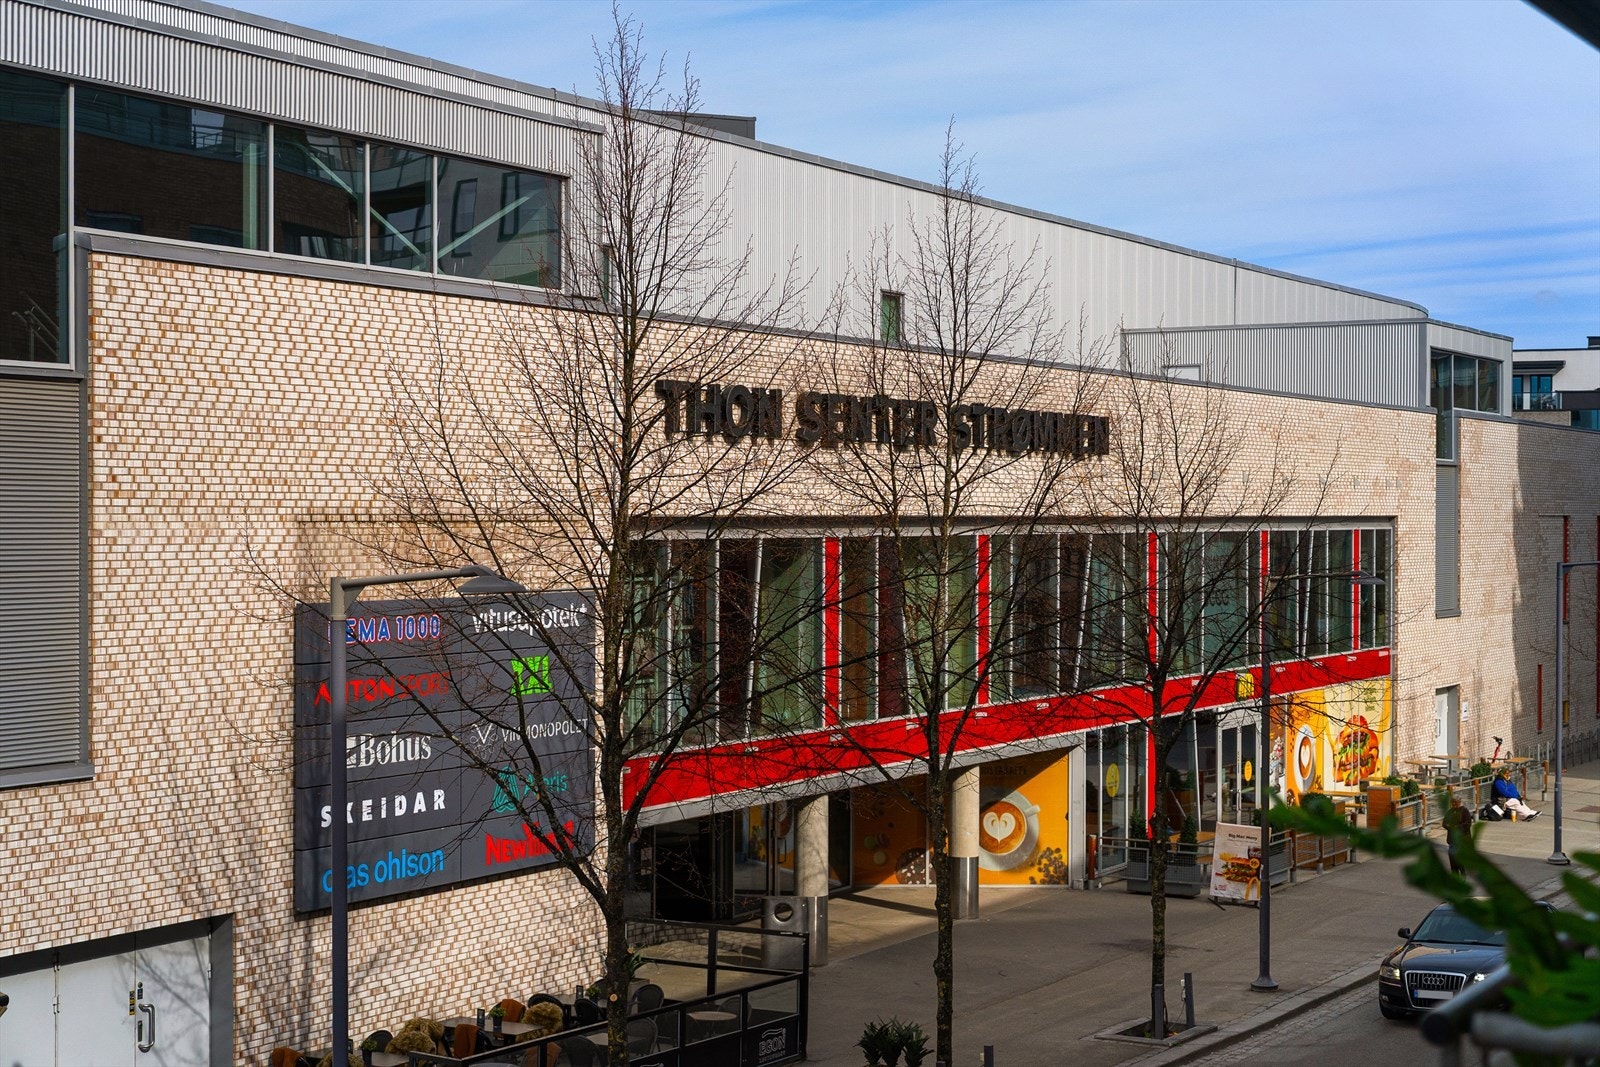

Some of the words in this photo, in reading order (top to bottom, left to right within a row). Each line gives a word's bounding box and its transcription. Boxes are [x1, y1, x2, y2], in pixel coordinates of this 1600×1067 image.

[655, 380, 782, 440] THON
[796, 391, 938, 447] SENTER
[950, 402, 1110, 455] STRØMMEN
[327, 616, 391, 645] EMA
[395, 614, 440, 641] 1000
[314, 676, 395, 707] ATON
[510, 655, 553, 695] XXL
[358, 731, 432, 768] Bohus
[523, 771, 568, 796] Aris
[321, 863, 370, 893] cas
[374, 849, 445, 883] ohlson
[759, 1032, 786, 1056] EGON
